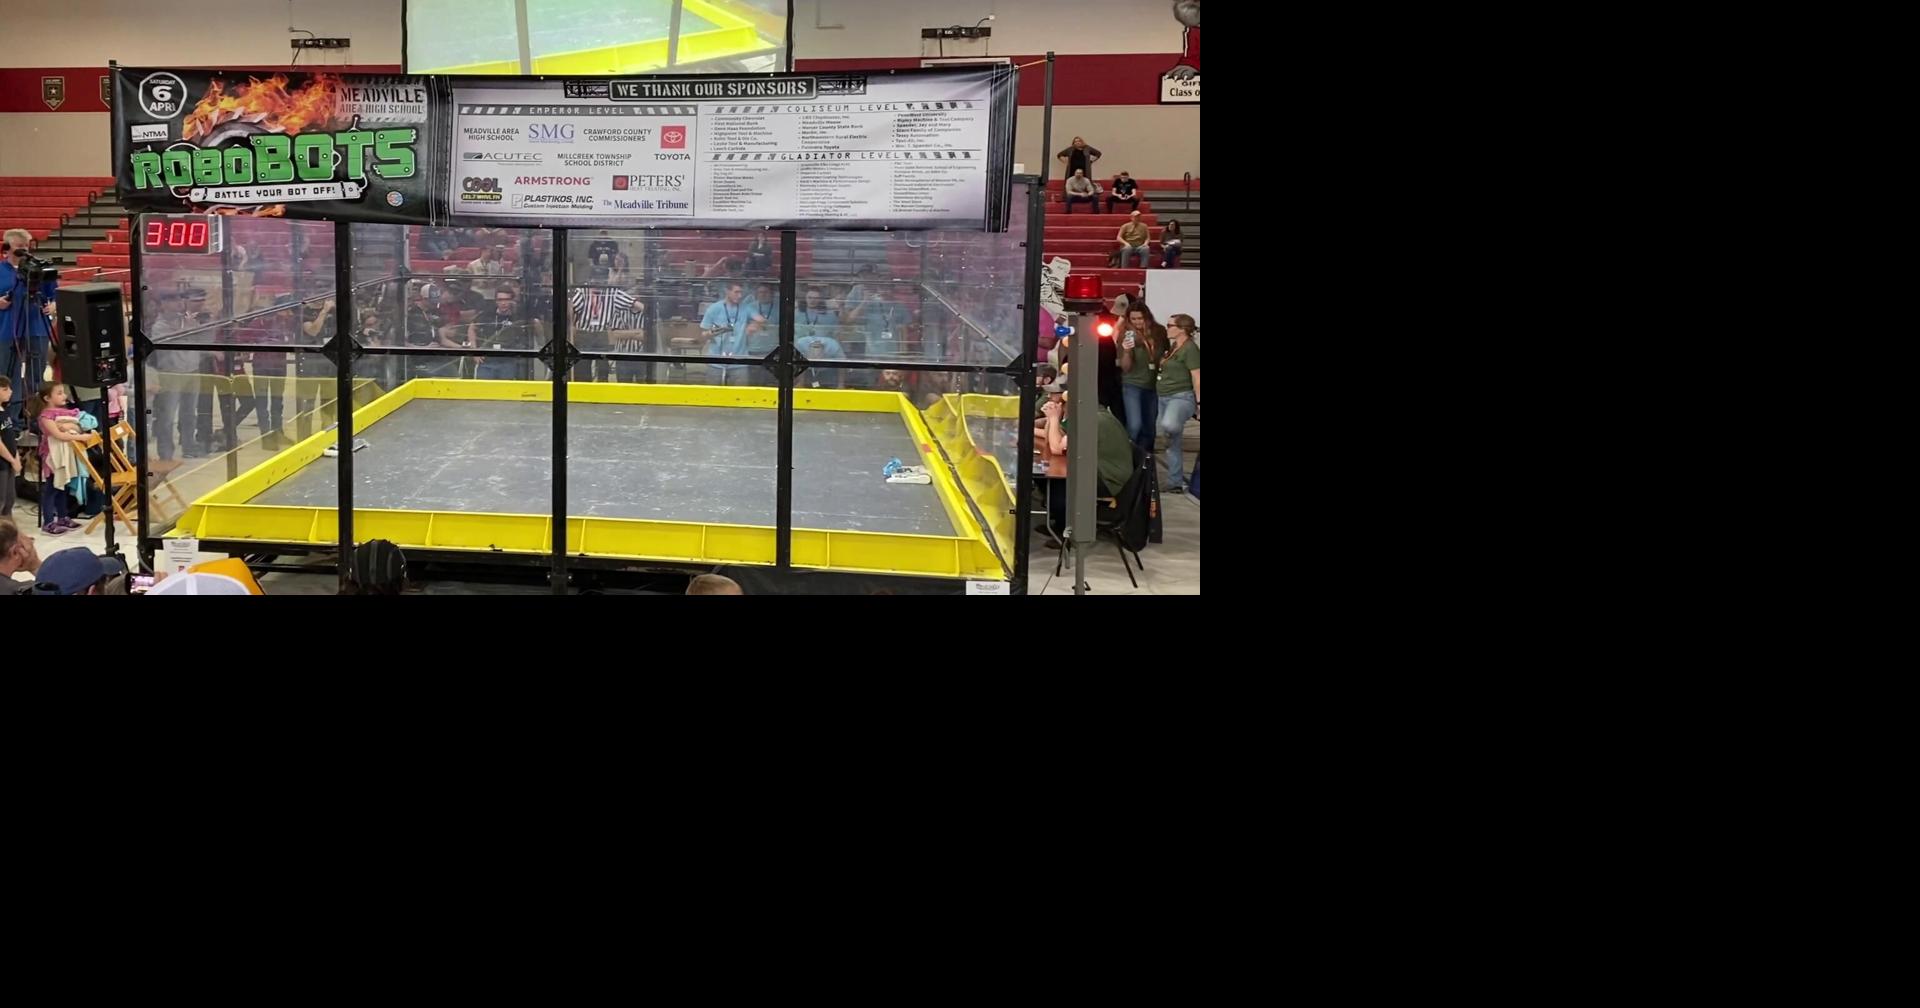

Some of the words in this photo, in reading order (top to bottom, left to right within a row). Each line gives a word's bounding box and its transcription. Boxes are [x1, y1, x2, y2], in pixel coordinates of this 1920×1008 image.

[152, 85, 173, 102] 6
[617, 84, 639, 97] WE
[642, 83, 691, 97] THANK
[694, 82, 723, 96] OUR
[727, 80, 807, 96] SPONSORS
[1170, 88, 1192, 96] Class
[341, 87, 425, 103] MEADVILLE
[365, 104, 386, 114] HIGH
[388, 104, 424, 114] SCHOOL
[787, 104, 849, 113] COLISEUM
[860, 104, 898, 112] LEVEL
[142, 130, 167, 138] NTMA
[528, 123, 575, 140] SMG
[131, 129, 416, 190] ROBOBOTS
[483, 152, 543, 160] ACUTEC
[781, 152, 851, 160] GLADIATOR
[861, 151, 900, 160] LEVEL
[462, 177, 502, 192] COOL
[514, 176, 590, 186] ARMSTRONG
[630, 175, 685, 187] PETERS'
[214, 190, 250, 199] BATTLE
[256, 189, 282, 197] YOUR
[288, 188, 308, 196] BOT
[313, 186, 336, 194] OFF!
[524, 195, 574, 204] PLASTIKOS,
[614, 200, 654, 209] Meadville
[656, 200, 689, 209] Tribune
[146, 222, 208, 247] 3:00
